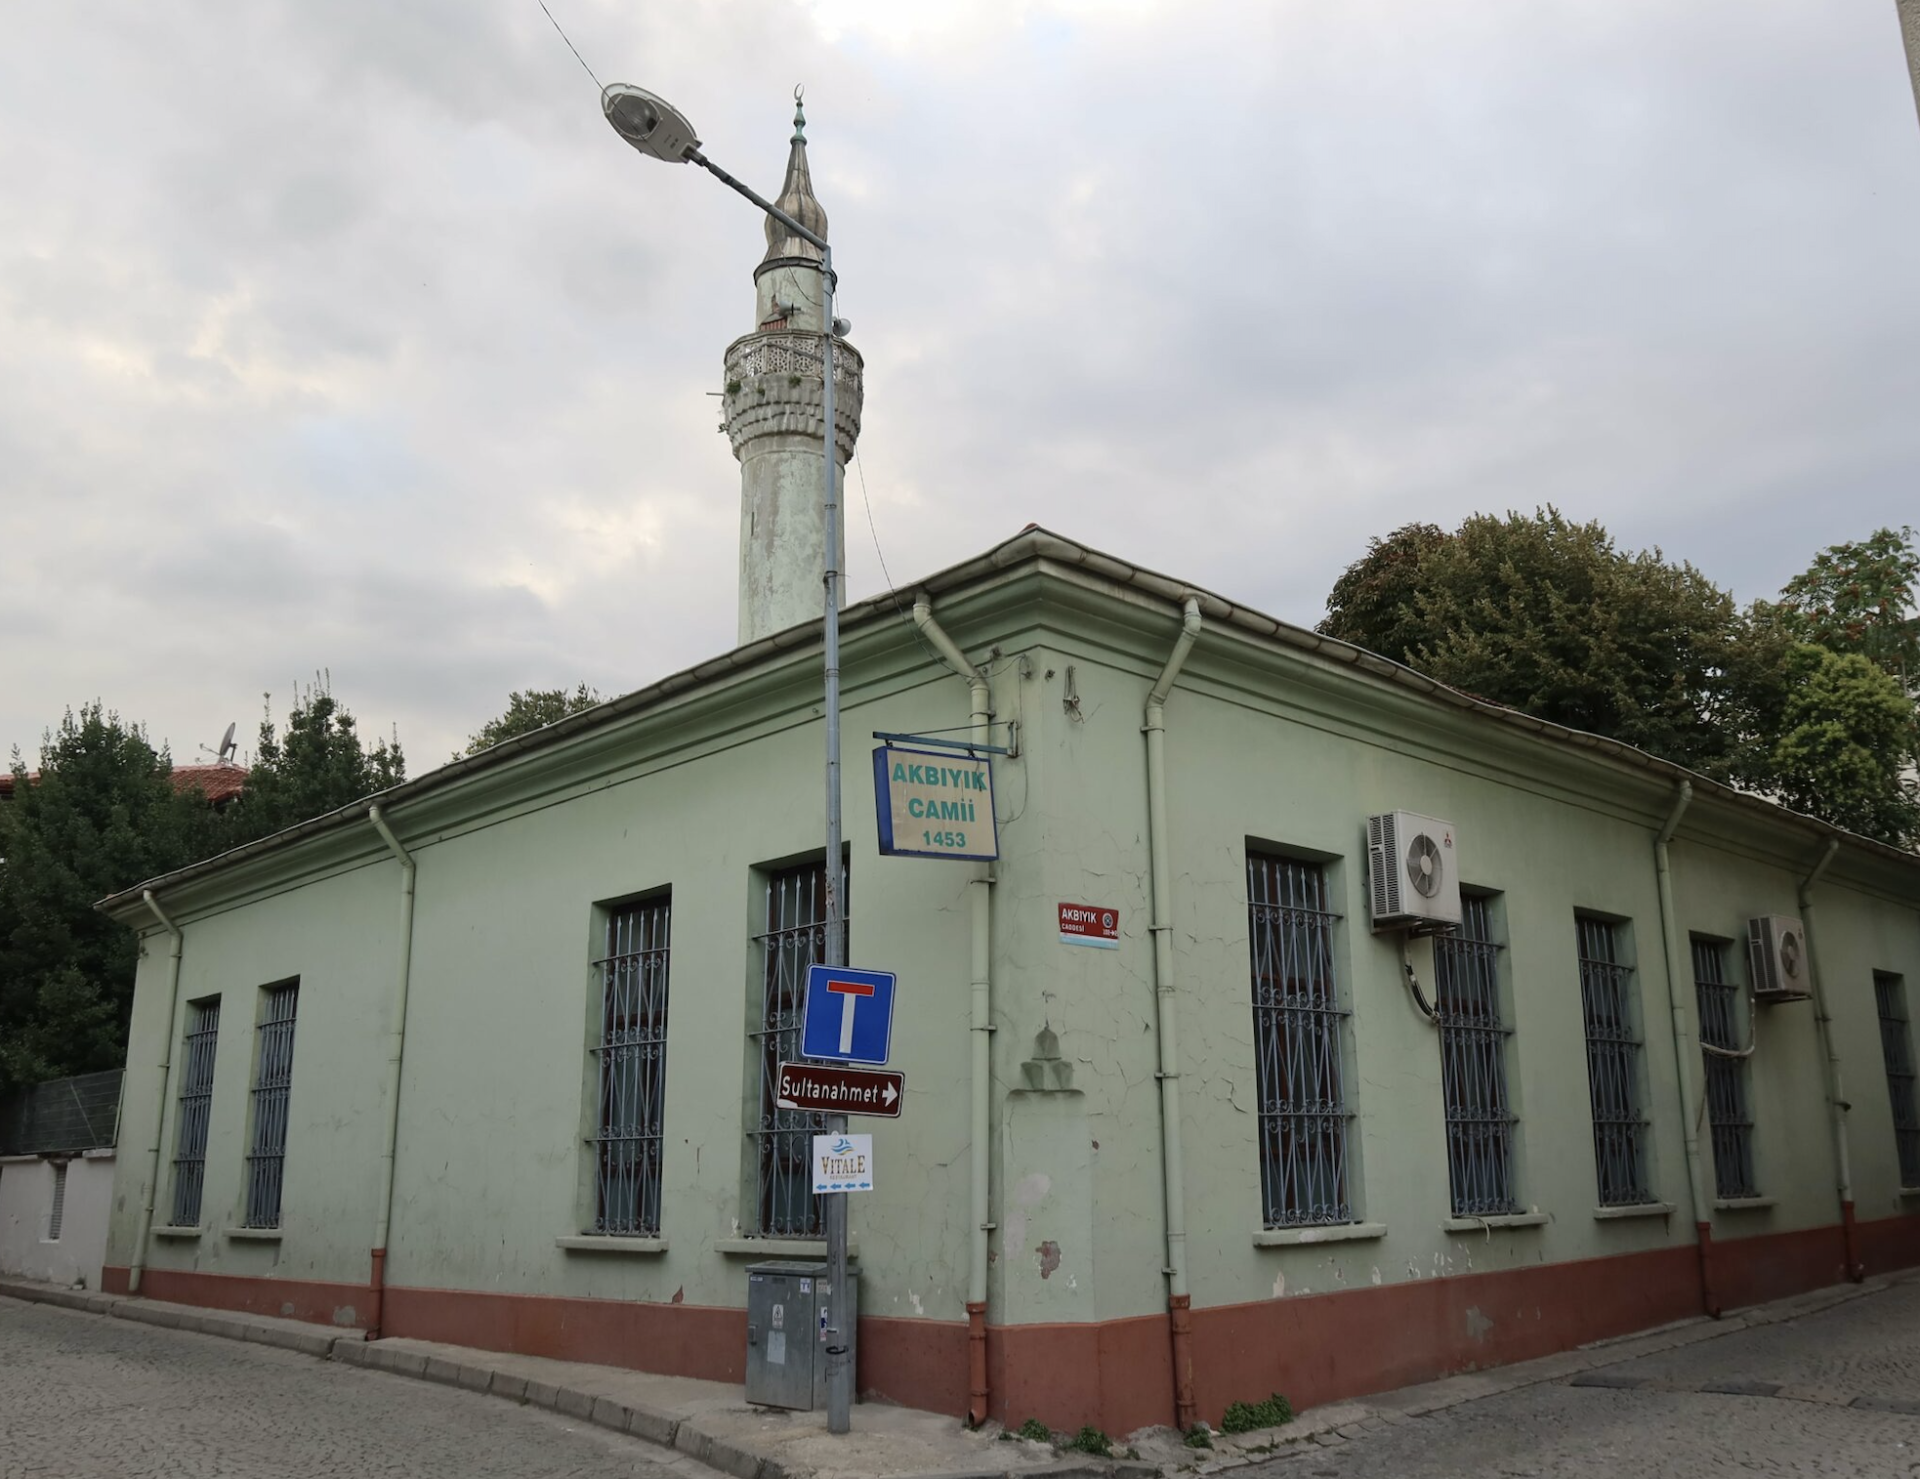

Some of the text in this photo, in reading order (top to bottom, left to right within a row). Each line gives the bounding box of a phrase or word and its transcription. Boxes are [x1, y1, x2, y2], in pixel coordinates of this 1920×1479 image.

[892, 763, 987, 791] AKBIYIK
[923, 830, 966, 848] 1453
[1061, 907, 1097, 924] AKBIYIK
[781, 1075, 879, 1103] Sultanahmet
[821, 1155, 866, 1175] VITALE
